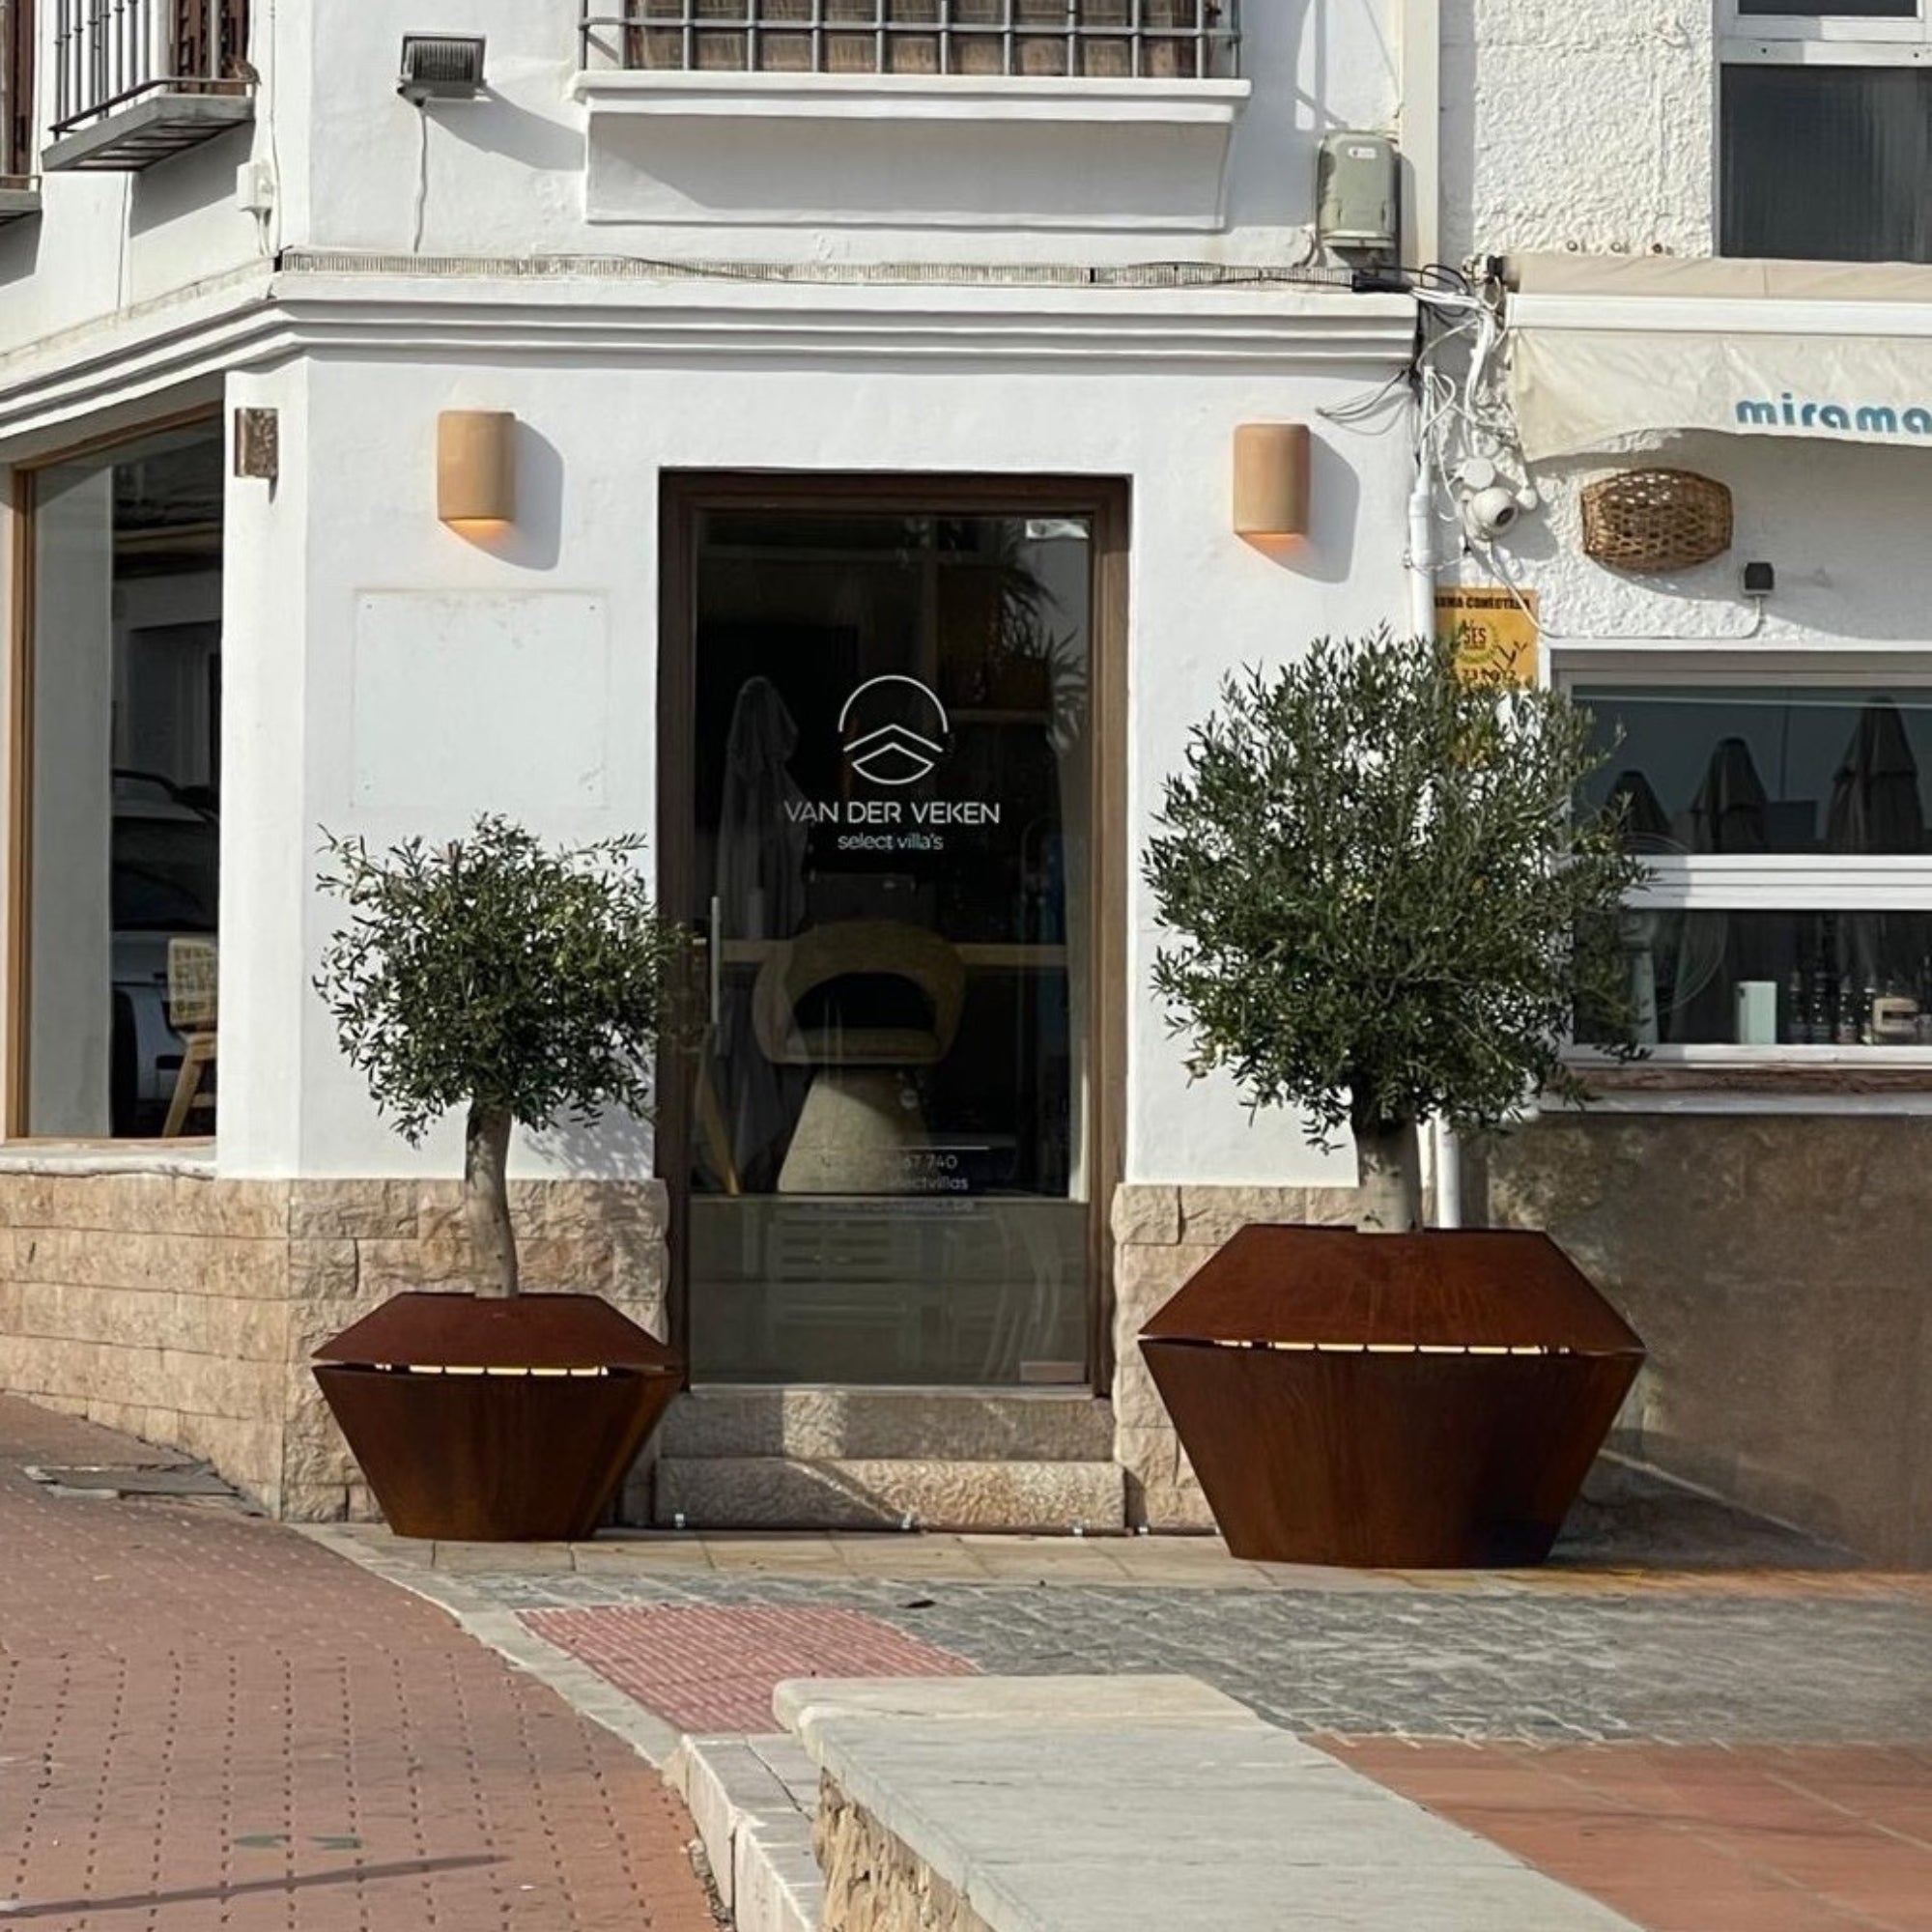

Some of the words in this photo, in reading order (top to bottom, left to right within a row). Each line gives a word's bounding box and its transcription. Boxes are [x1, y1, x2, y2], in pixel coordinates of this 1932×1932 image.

[783, 801, 838, 823] VAN
[847, 801, 901, 823] DER
[910, 801, 1000, 823] VEKEN
[838, 833, 893, 850] select
[896, 833, 944, 850] villa's
